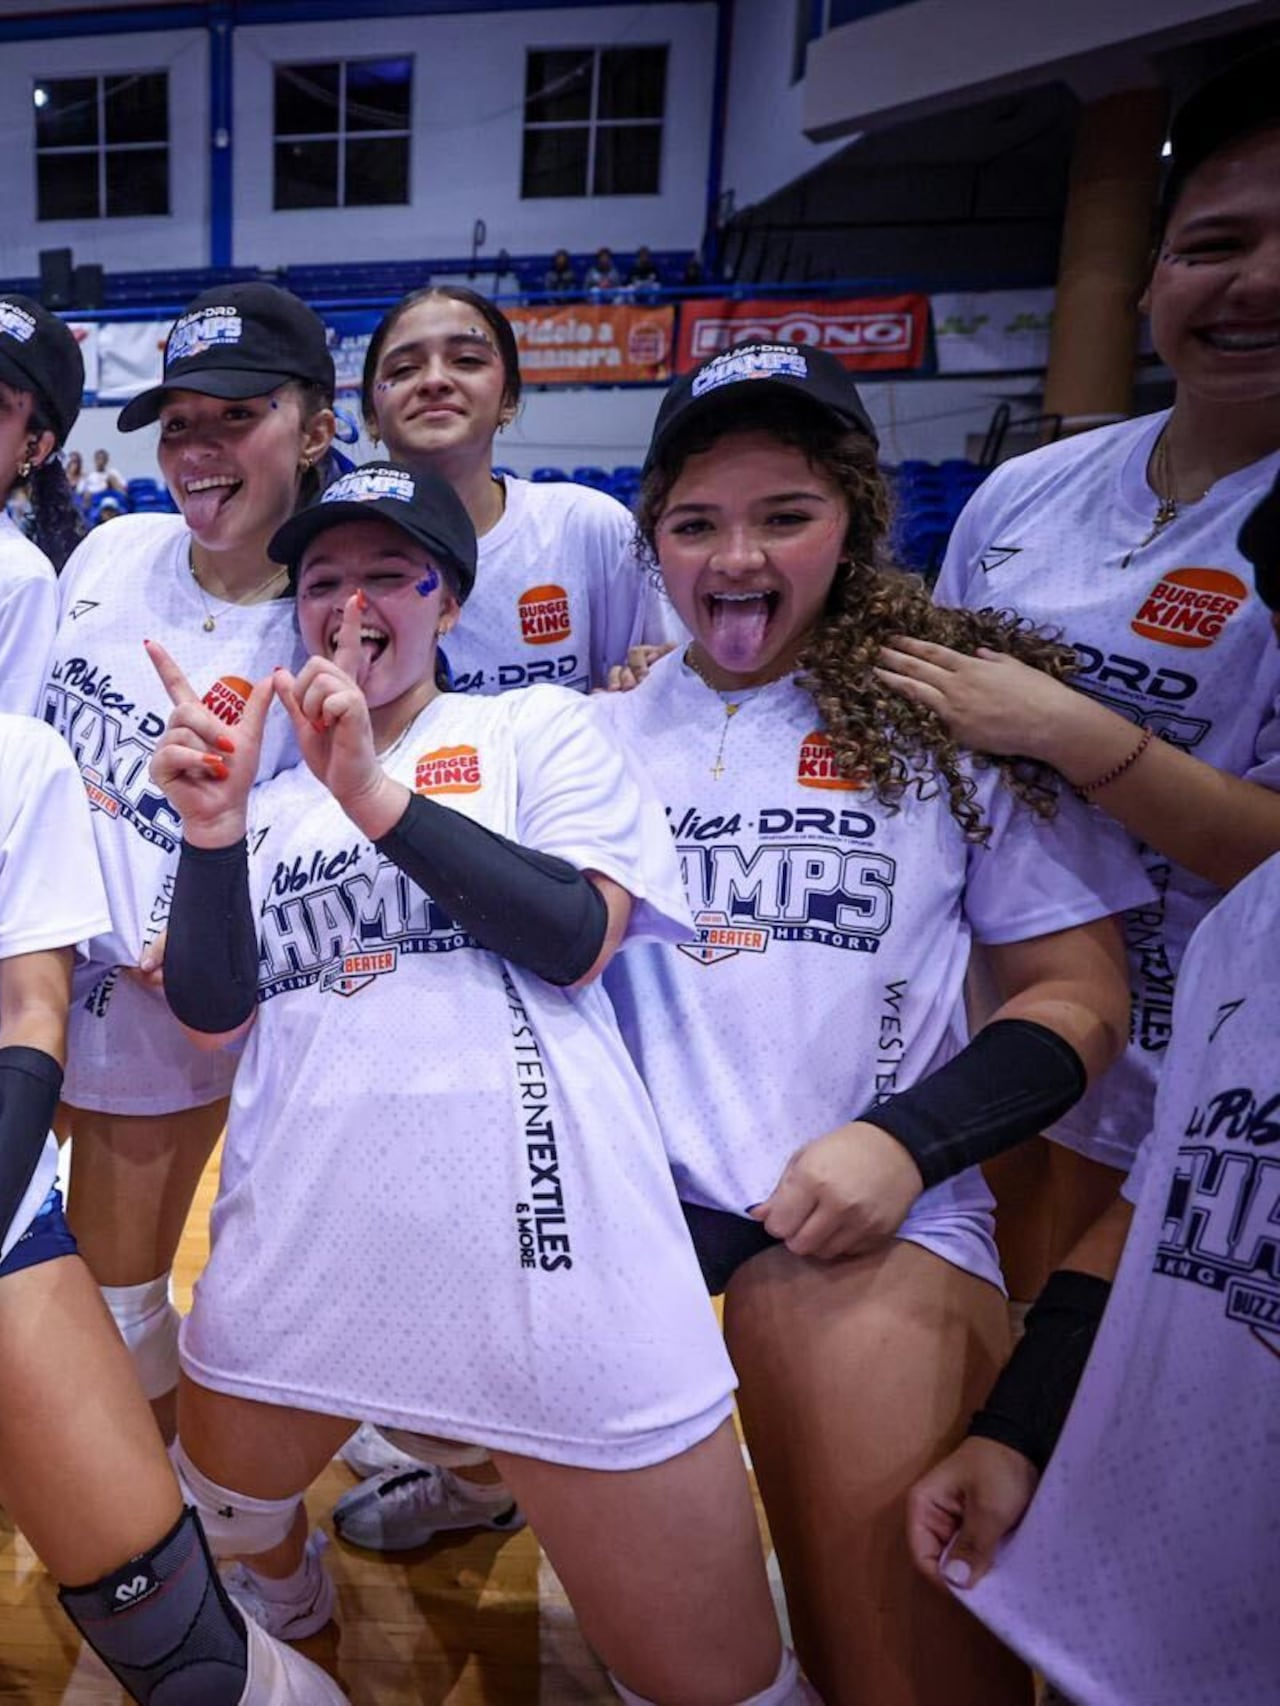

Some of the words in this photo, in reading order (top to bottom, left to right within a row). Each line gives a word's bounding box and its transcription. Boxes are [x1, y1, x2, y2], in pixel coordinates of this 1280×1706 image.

[205, 306, 237, 317] DRD
[520, 601, 568, 619] BURGER
[1151, 583, 1239, 616] BURGER
[521, 614, 569, 636] KING
[1136, 600, 1226, 638] KING
[498, 655, 577, 686] DRD
[202, 692, 240, 726] KIN
[211, 683, 246, 712] BURG
[801, 746, 835, 759] BUR
[416, 755, 479, 774] BURGER
[798, 760, 837, 777] KI
[416, 767, 481, 788] KING
[122, 806, 176, 850] ISTORY
[758, 808, 876, 839] DRD
[677, 845, 897, 936] AMPS
[403, 936, 465, 952] HISTO
[776, 927, 877, 950] HISTORY
[265, 975, 318, 998] AKING
[518, 1218, 536, 1268] MORE
